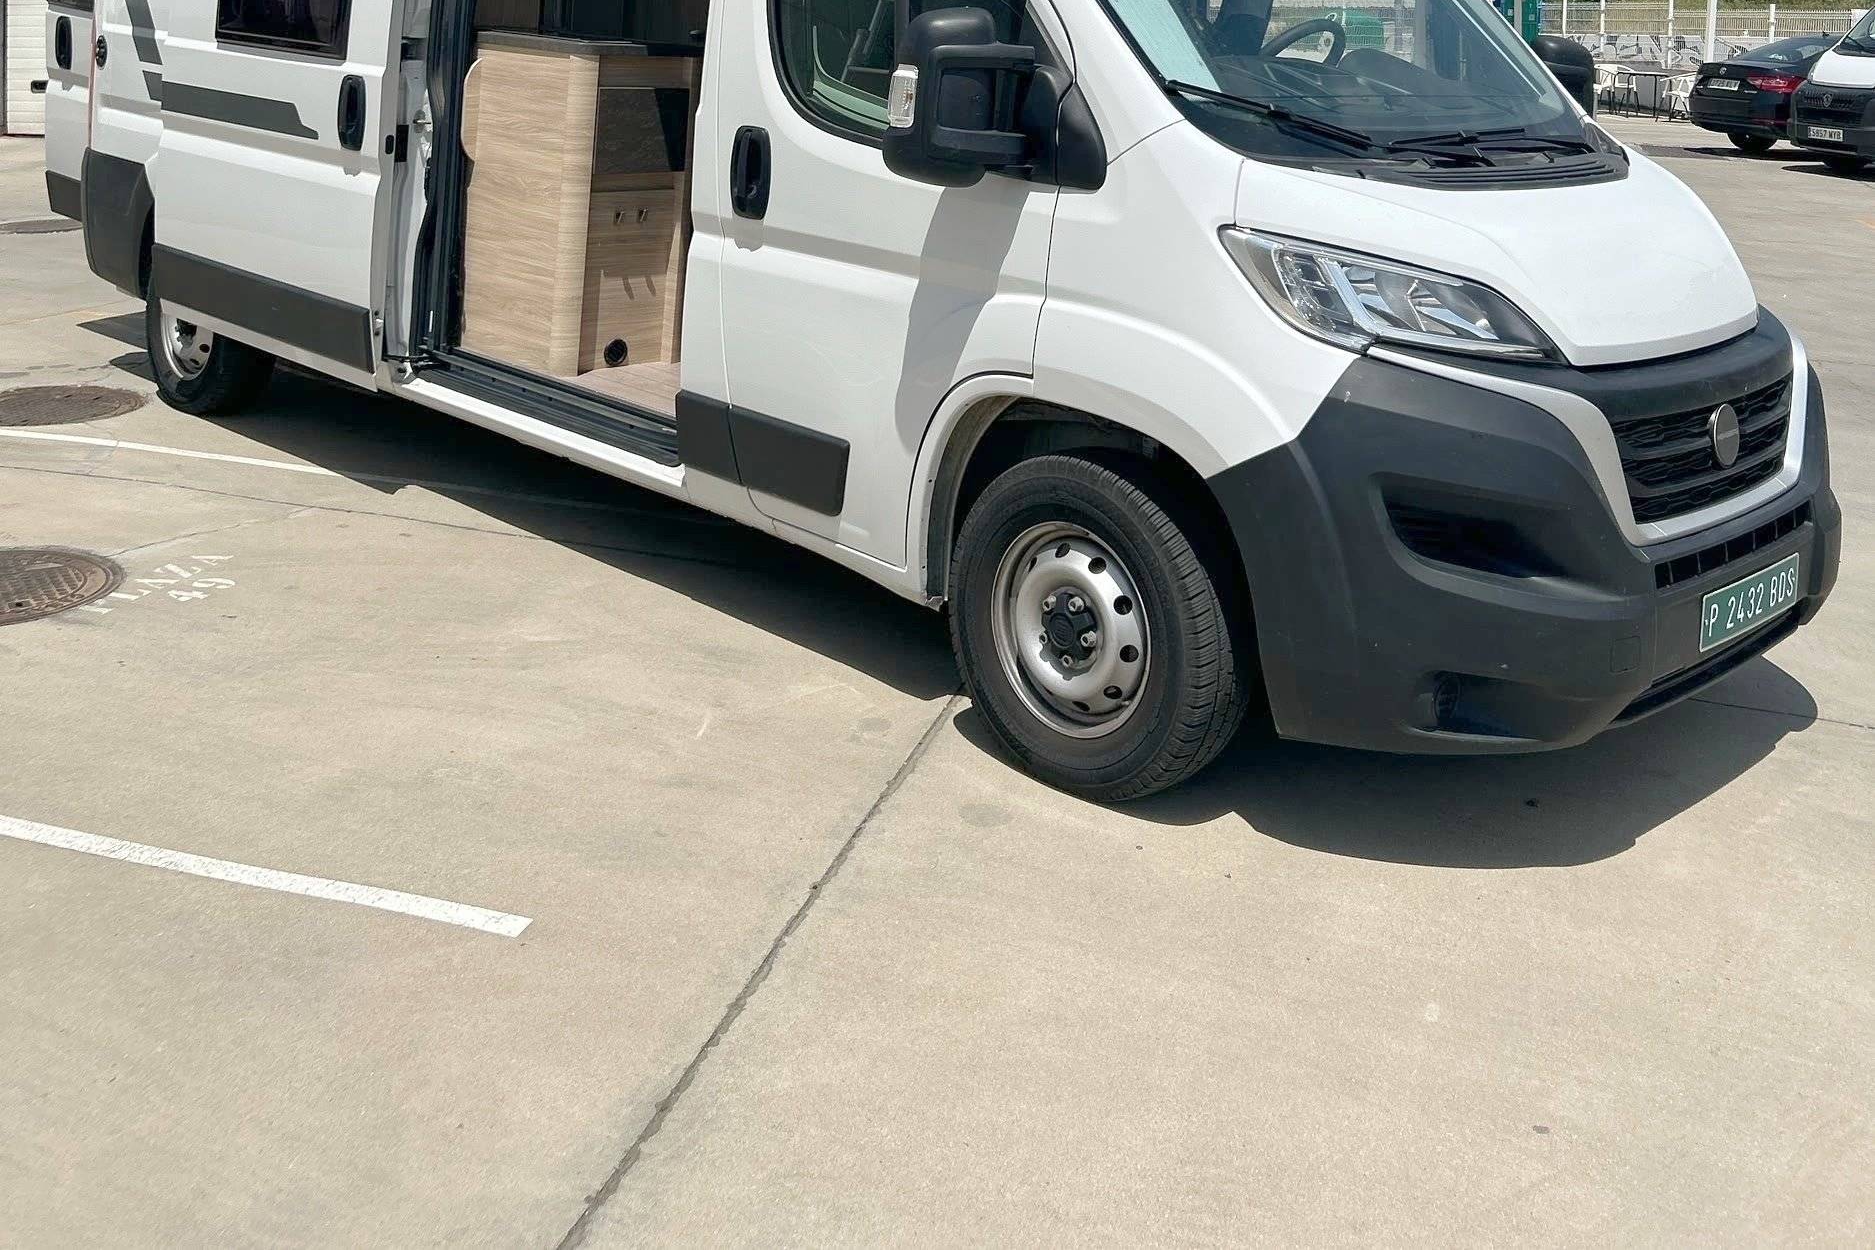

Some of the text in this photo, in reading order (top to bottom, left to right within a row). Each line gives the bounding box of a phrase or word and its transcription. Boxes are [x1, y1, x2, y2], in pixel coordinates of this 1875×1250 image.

[167, 577, 236, 601] 49
[1708, 567, 1795, 638] P 2432 BDS
